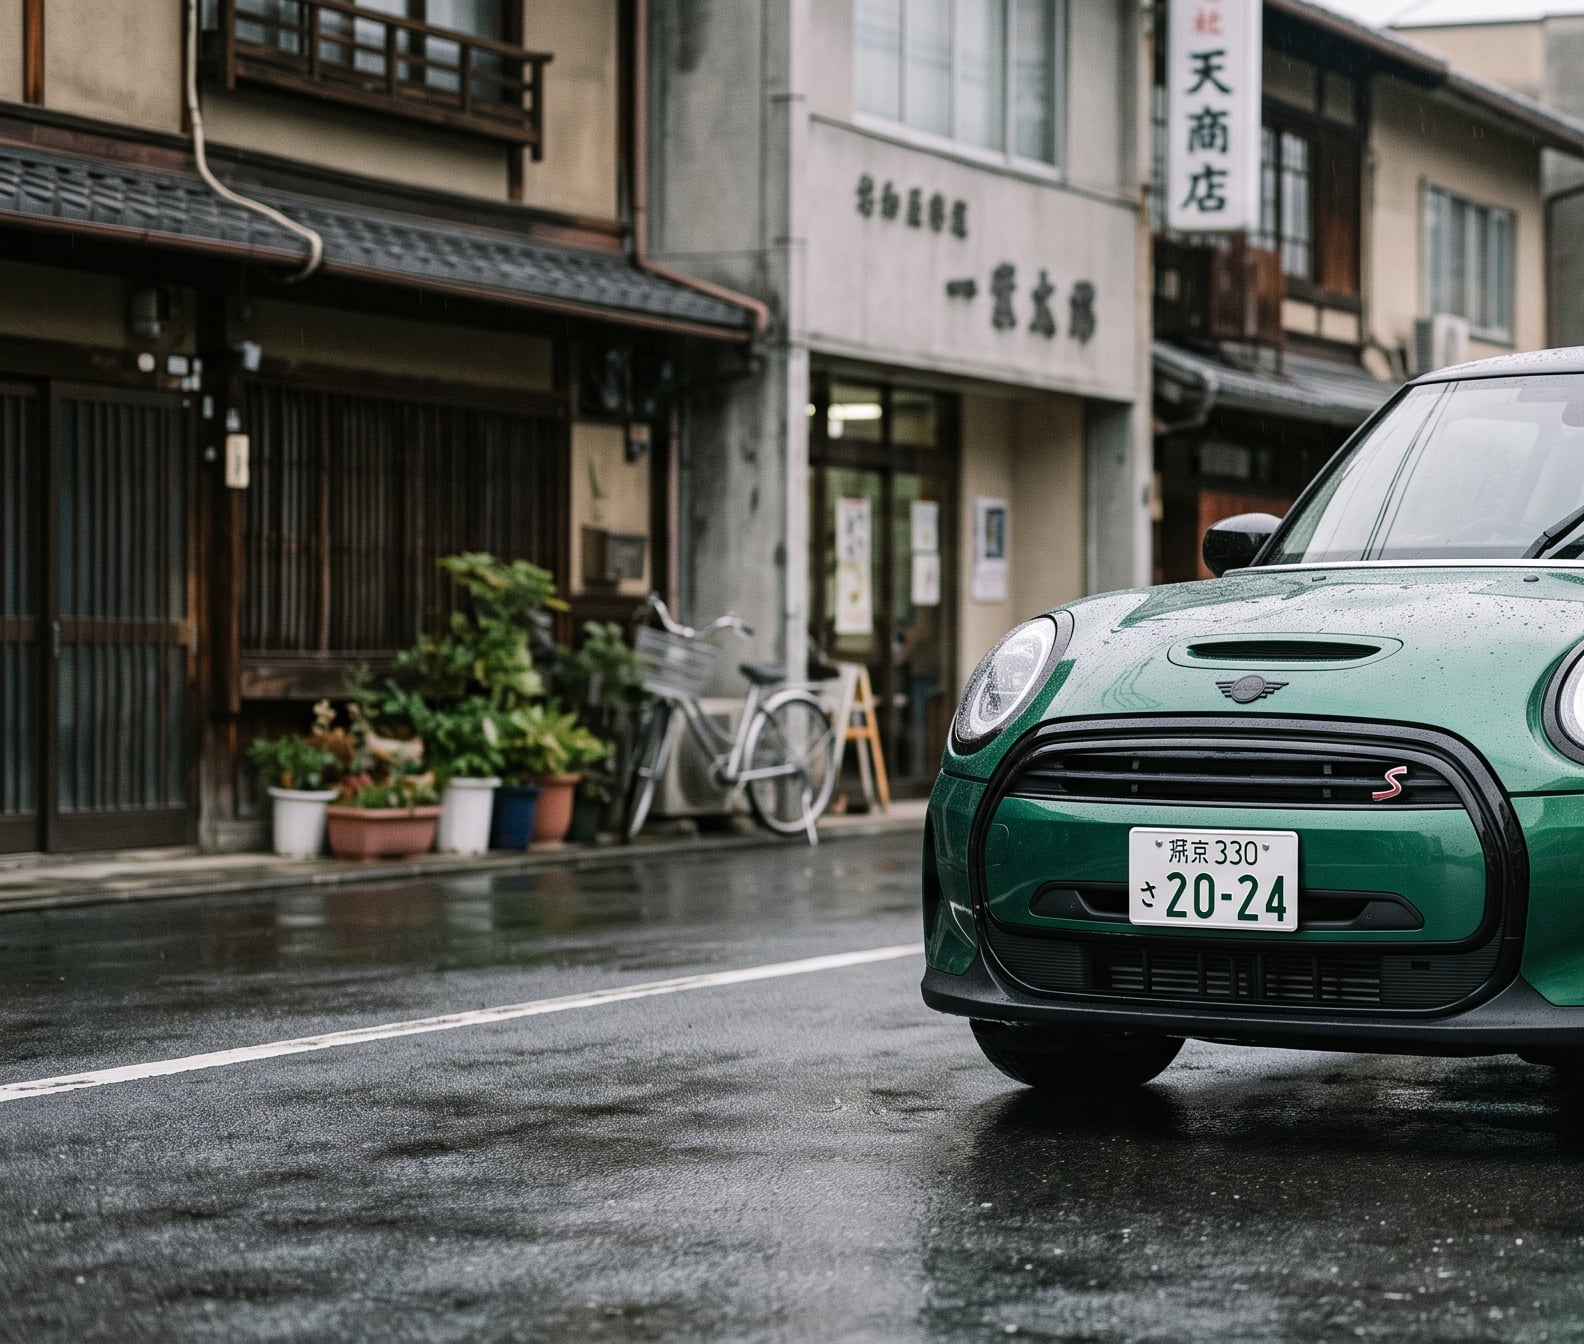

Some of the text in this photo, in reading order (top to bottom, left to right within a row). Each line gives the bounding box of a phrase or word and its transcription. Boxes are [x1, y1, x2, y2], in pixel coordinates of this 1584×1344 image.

[1181, 50, 1232, 213] 天商店
[1372, 766, 1407, 801] S
[1215, 840, 1258, 866] 330
[1140, 872, 1287, 922] さ 20-24
